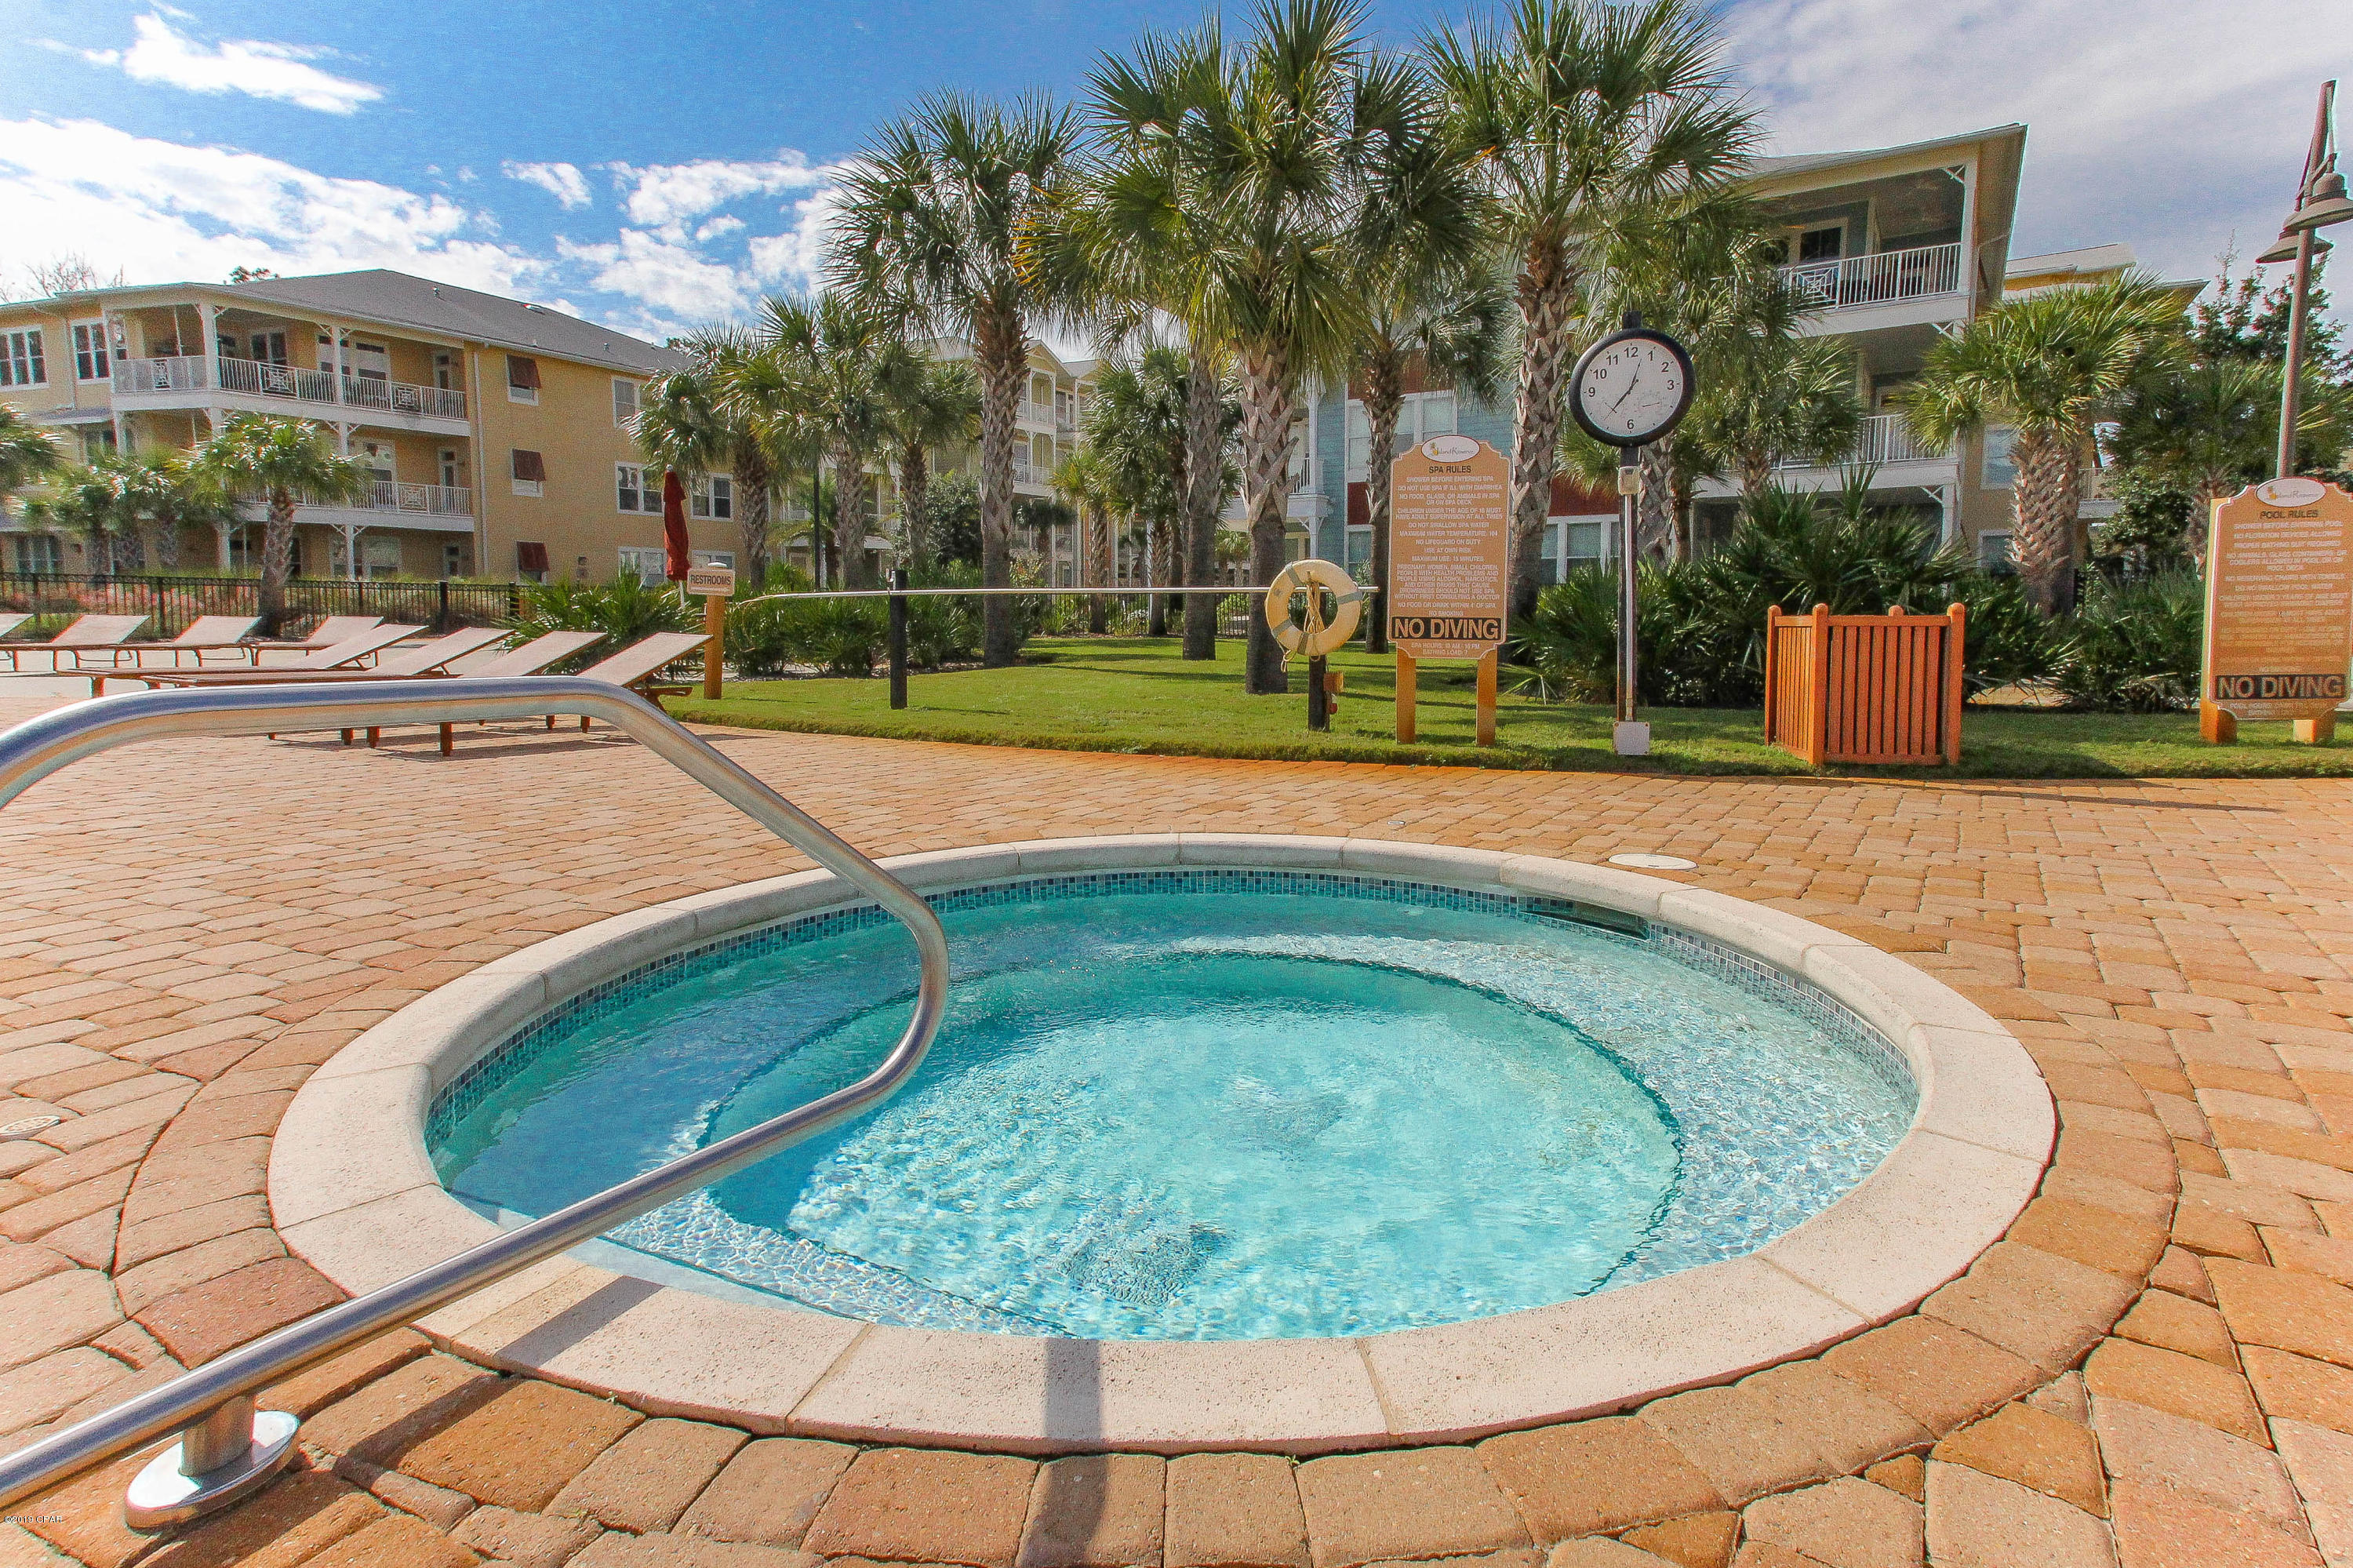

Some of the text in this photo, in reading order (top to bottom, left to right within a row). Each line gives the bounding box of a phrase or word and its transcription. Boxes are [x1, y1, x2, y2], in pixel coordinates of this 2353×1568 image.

[1624, 347, 1638, 358] 12
[1648, 351, 1653, 361] 1
[1606, 355, 1618, 365] 11
[1661, 362, 1668, 373] 2
[1593, 369, 1606, 380] 10
[1667, 380, 1674, 390] 3
[1588, 387, 1595, 397] 9
[1627, 419, 1634, 429] 6
[2288, 510, 2318, 518] RULES
[691, 575, 731, 585] RESTROOMS
[1395, 618, 1498, 638] NO DIVING
[2219, 676, 2344, 698] NO DIVING
